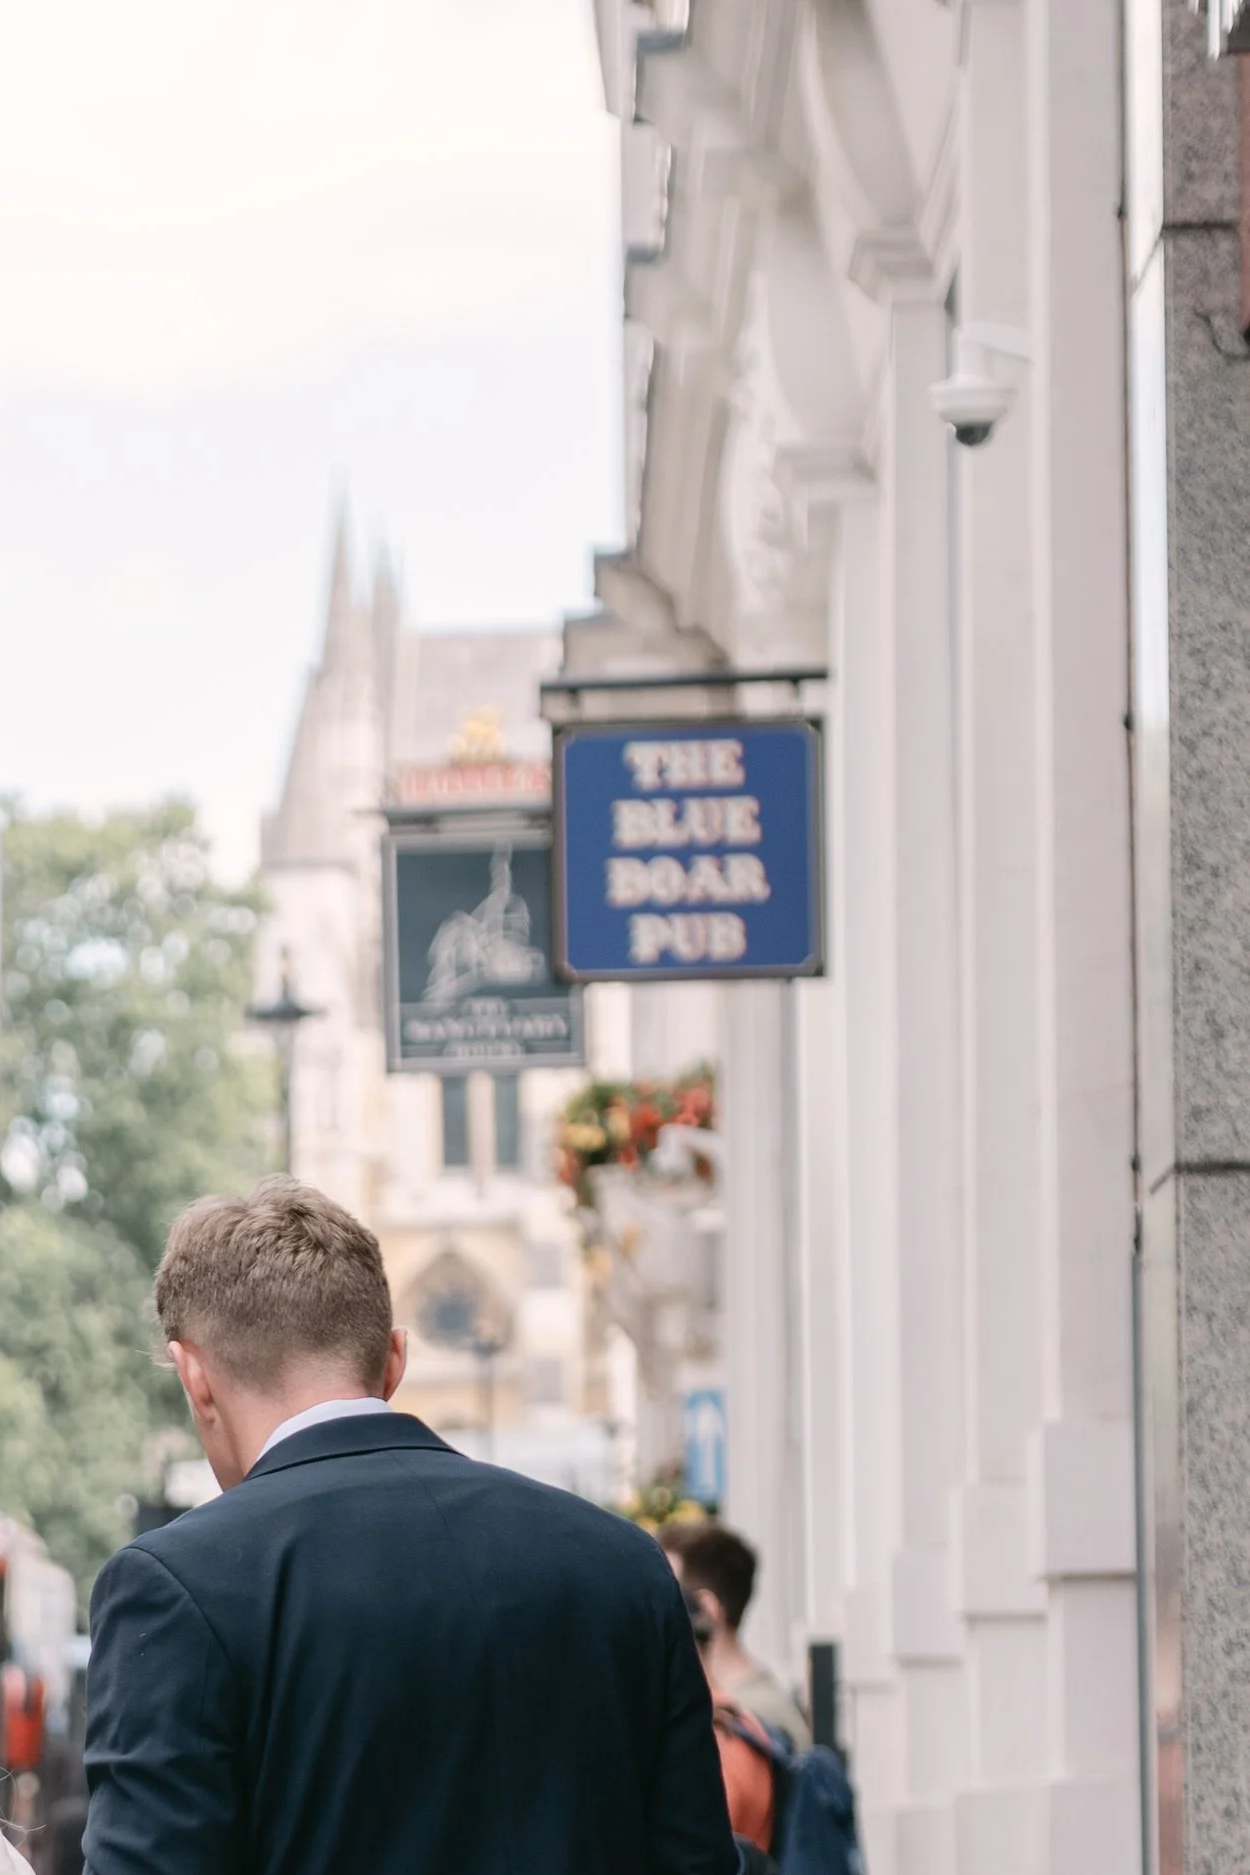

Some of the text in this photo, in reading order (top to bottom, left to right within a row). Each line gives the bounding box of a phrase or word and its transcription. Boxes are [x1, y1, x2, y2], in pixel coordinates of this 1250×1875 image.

[624, 739, 745, 790] THE
[611, 795, 763, 850] BLUE
[604, 853, 772, 908] BOAR
[629, 911, 747, 964] PUB
